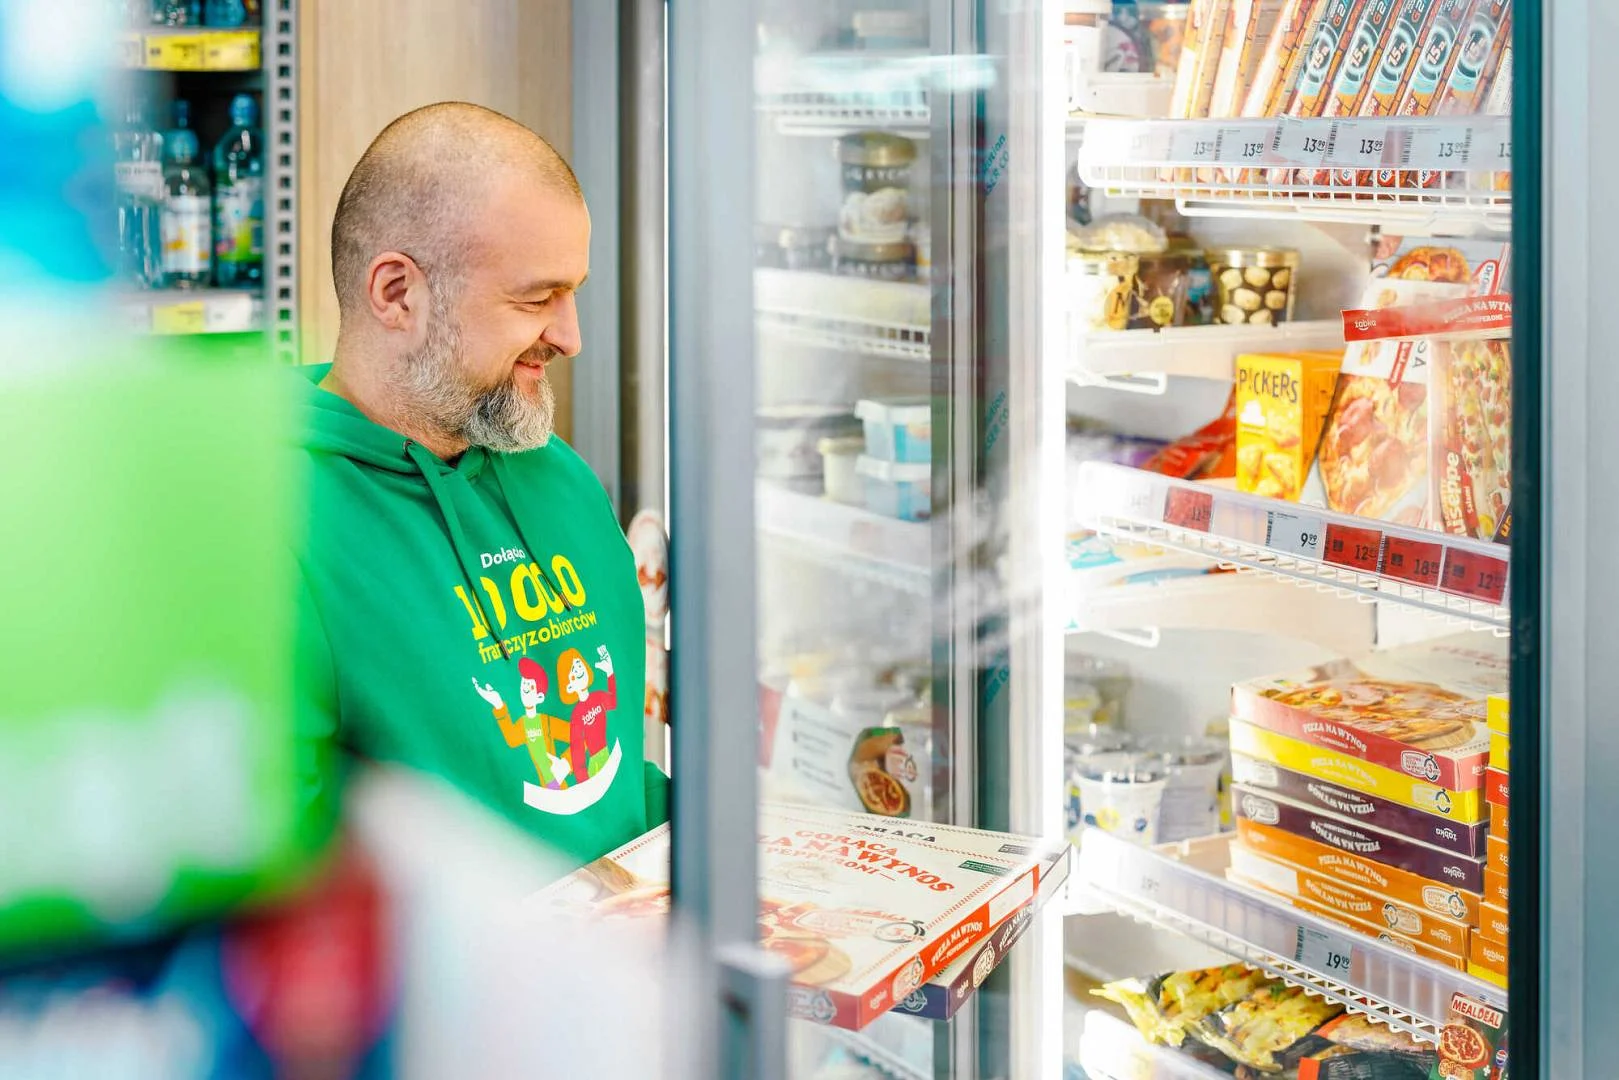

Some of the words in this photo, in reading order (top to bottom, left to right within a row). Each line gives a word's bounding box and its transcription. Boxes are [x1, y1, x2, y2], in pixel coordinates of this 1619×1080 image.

[1239, 367, 1299, 404] PICKERS
[1325, 722, 1338, 736] NA
[1337, 728, 1368, 753] WYNOS
[1340, 838, 1355, 851] NA
[1354, 840, 1382, 853] PIZZA
[856, 850, 955, 892] WYNOS
